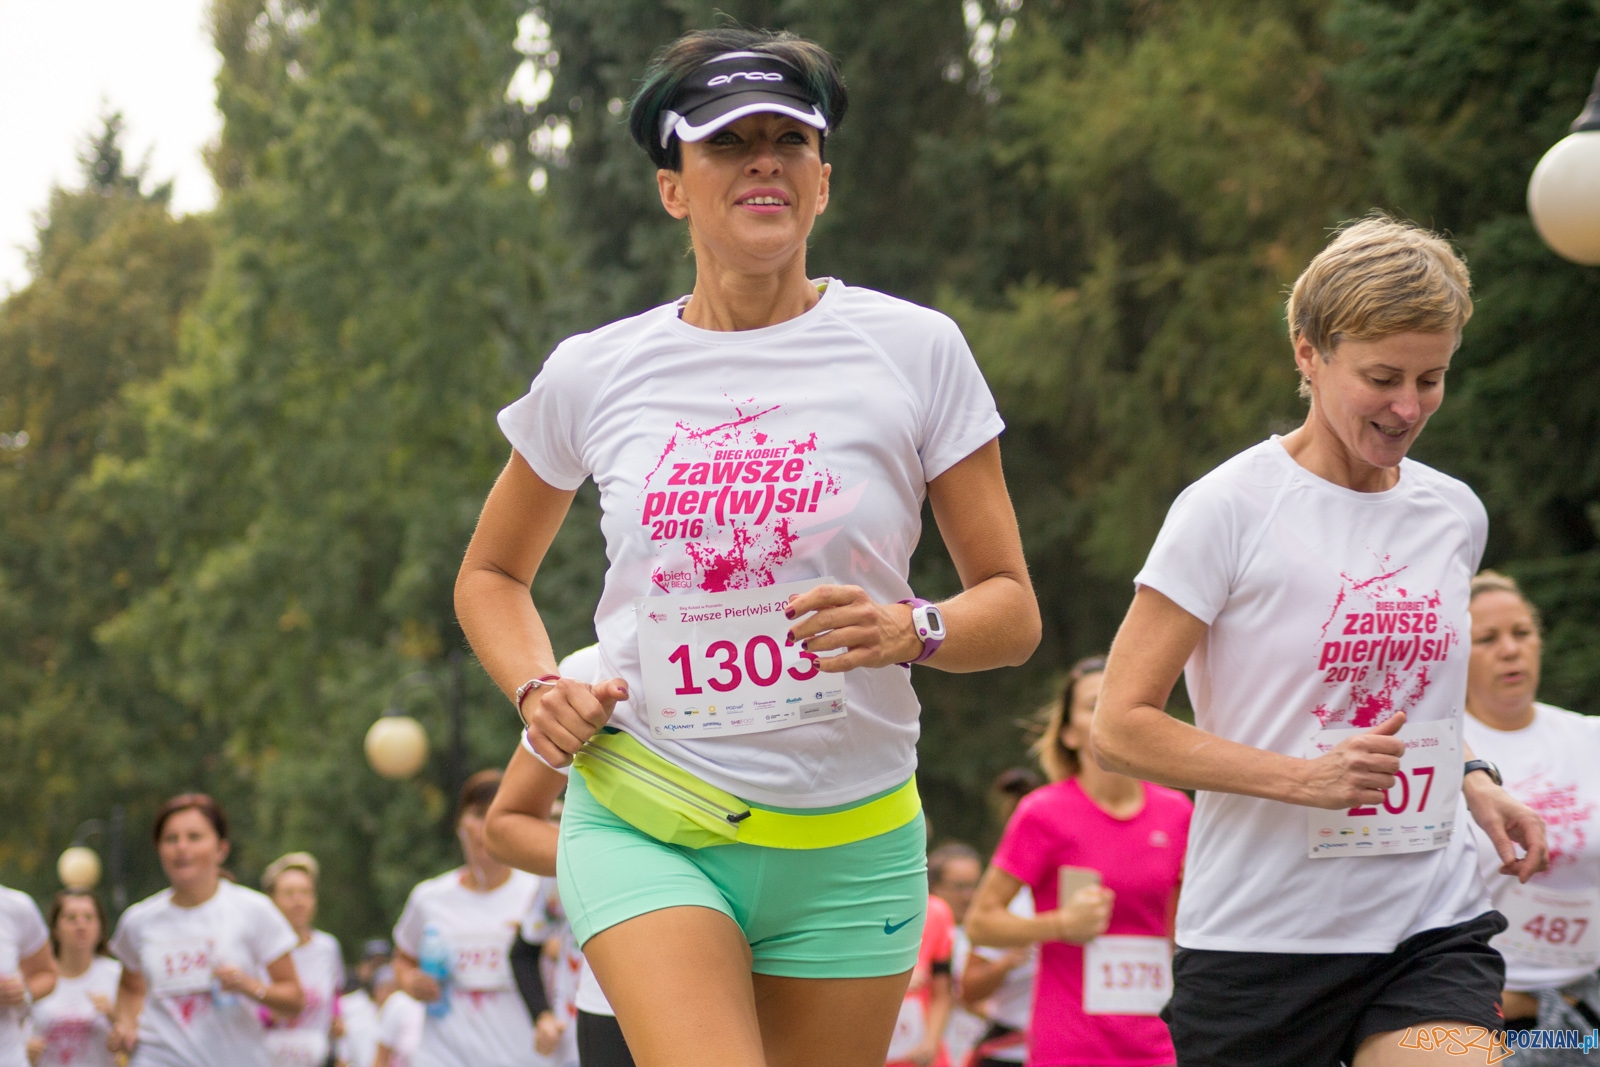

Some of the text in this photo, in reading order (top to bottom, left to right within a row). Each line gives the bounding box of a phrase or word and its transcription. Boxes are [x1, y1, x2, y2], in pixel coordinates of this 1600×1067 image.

[714, 447, 790, 460] BIEG KOBIET
[667, 458, 805, 486] zawsze
[641, 480, 823, 526] pier(w)si!
[650, 518, 704, 541] 2016
[671, 580, 692, 588] BIEGU
[680, 611, 722, 623] Zawsze
[724, 602, 772, 619] Pier(w)si
[1376, 601, 1425, 612] BIEG KOBIET
[1342, 611, 1438, 635] zawsze
[668, 635, 820, 695] 1303
[1324, 666, 1369, 683] 2016
[1348, 766, 1435, 816] 07
[1522, 914, 1589, 945] 487
